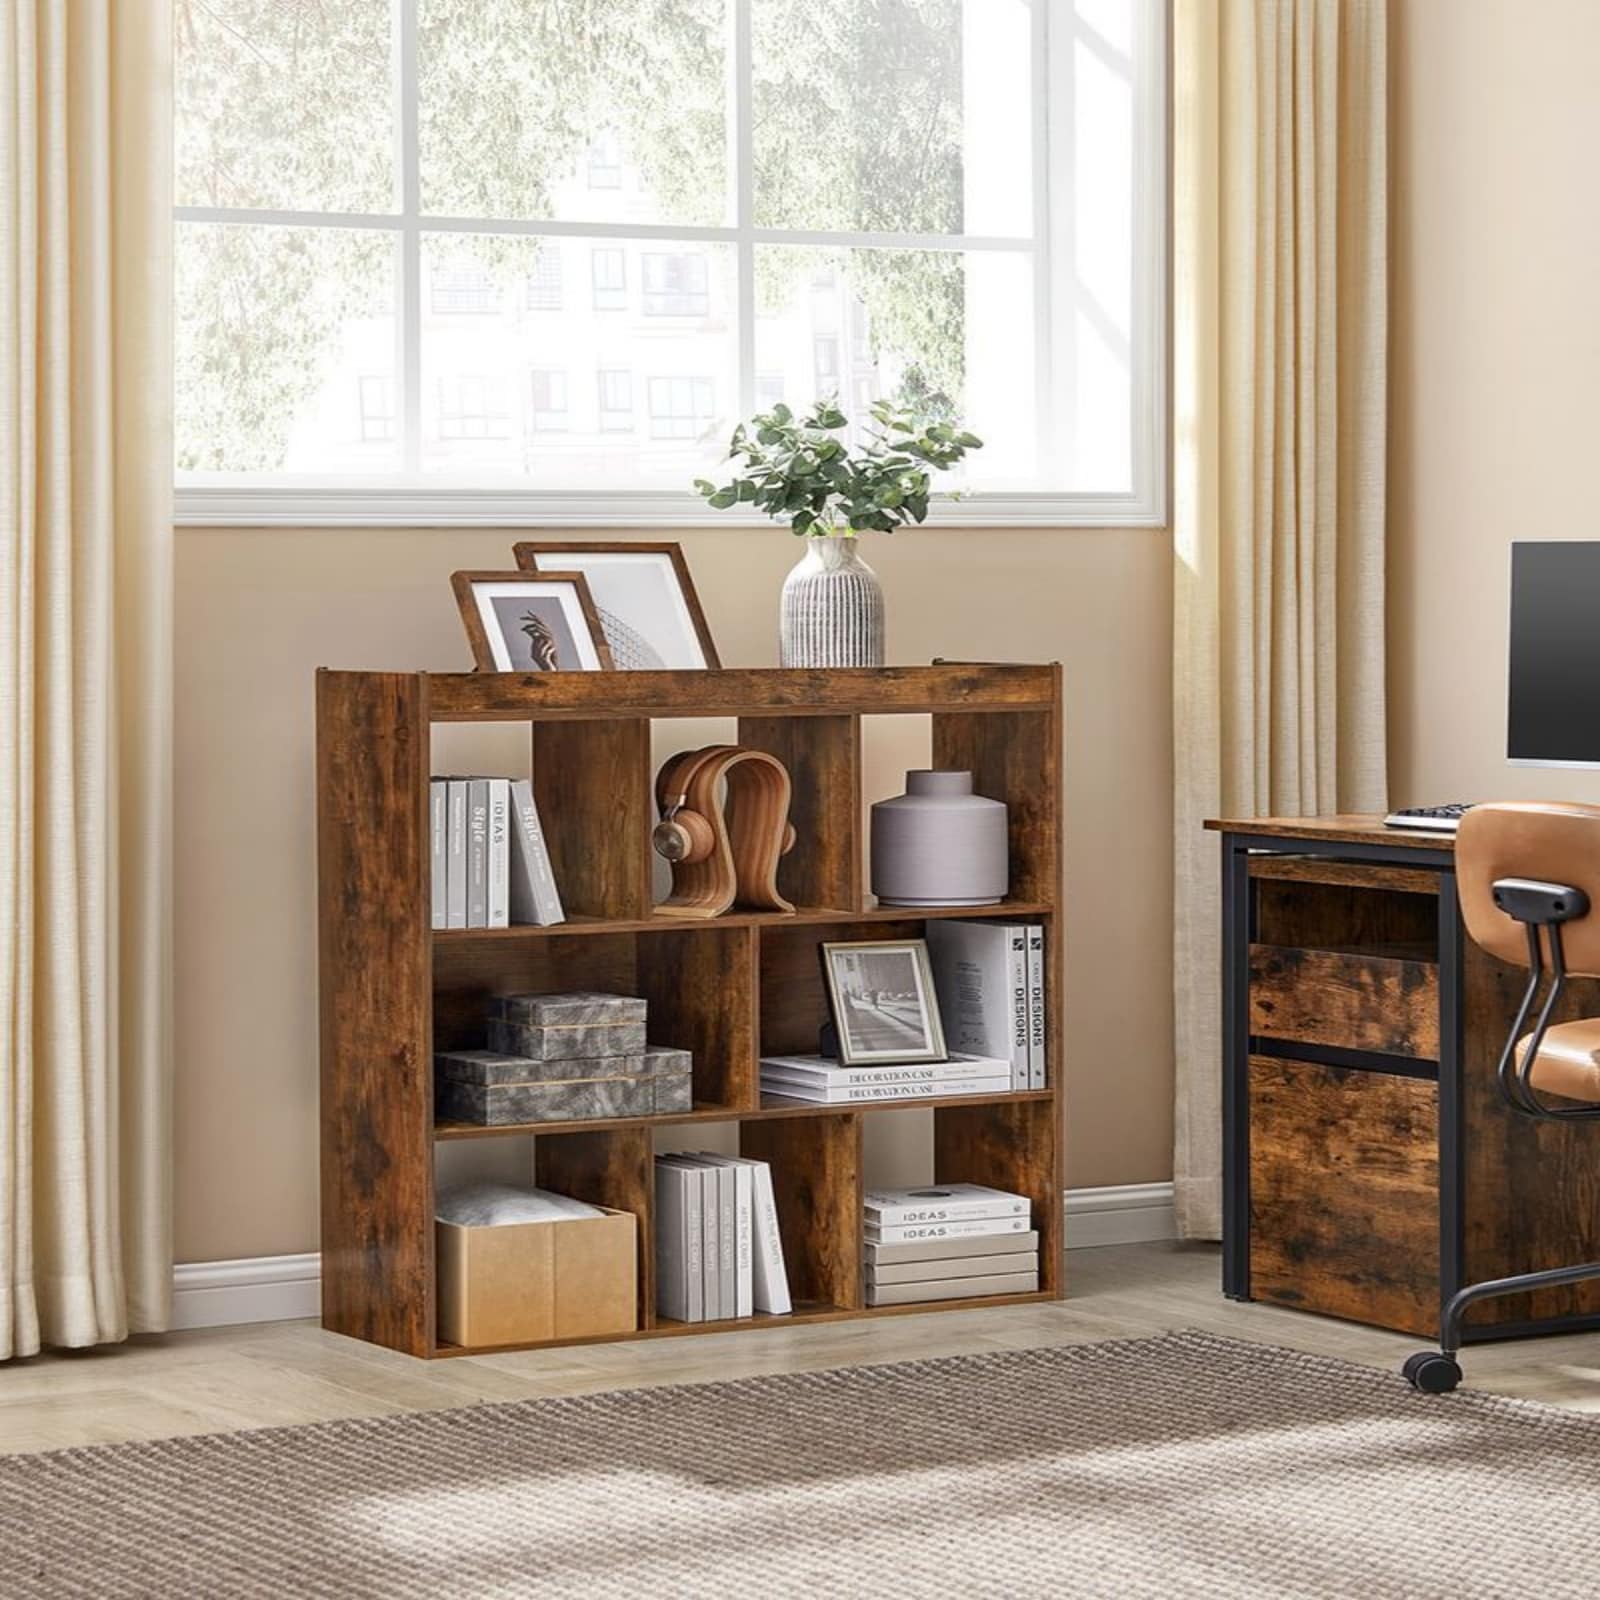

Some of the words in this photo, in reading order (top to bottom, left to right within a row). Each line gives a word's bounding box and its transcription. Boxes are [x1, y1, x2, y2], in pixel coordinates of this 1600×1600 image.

[472, 807, 487, 843] Style
[494, 801, 504, 844] IDEAS
[522, 807, 540, 842] Style
[1015, 987, 1026, 1047] DESIGNS
[1032, 986, 1043, 1046] DESIGNS
[849, 1071, 911, 1084] DECORATION
[849, 1086, 911, 1099] DECORATION
[904, 1211, 947, 1222] IDEAS
[904, 1228, 947, 1239] IDEAS
